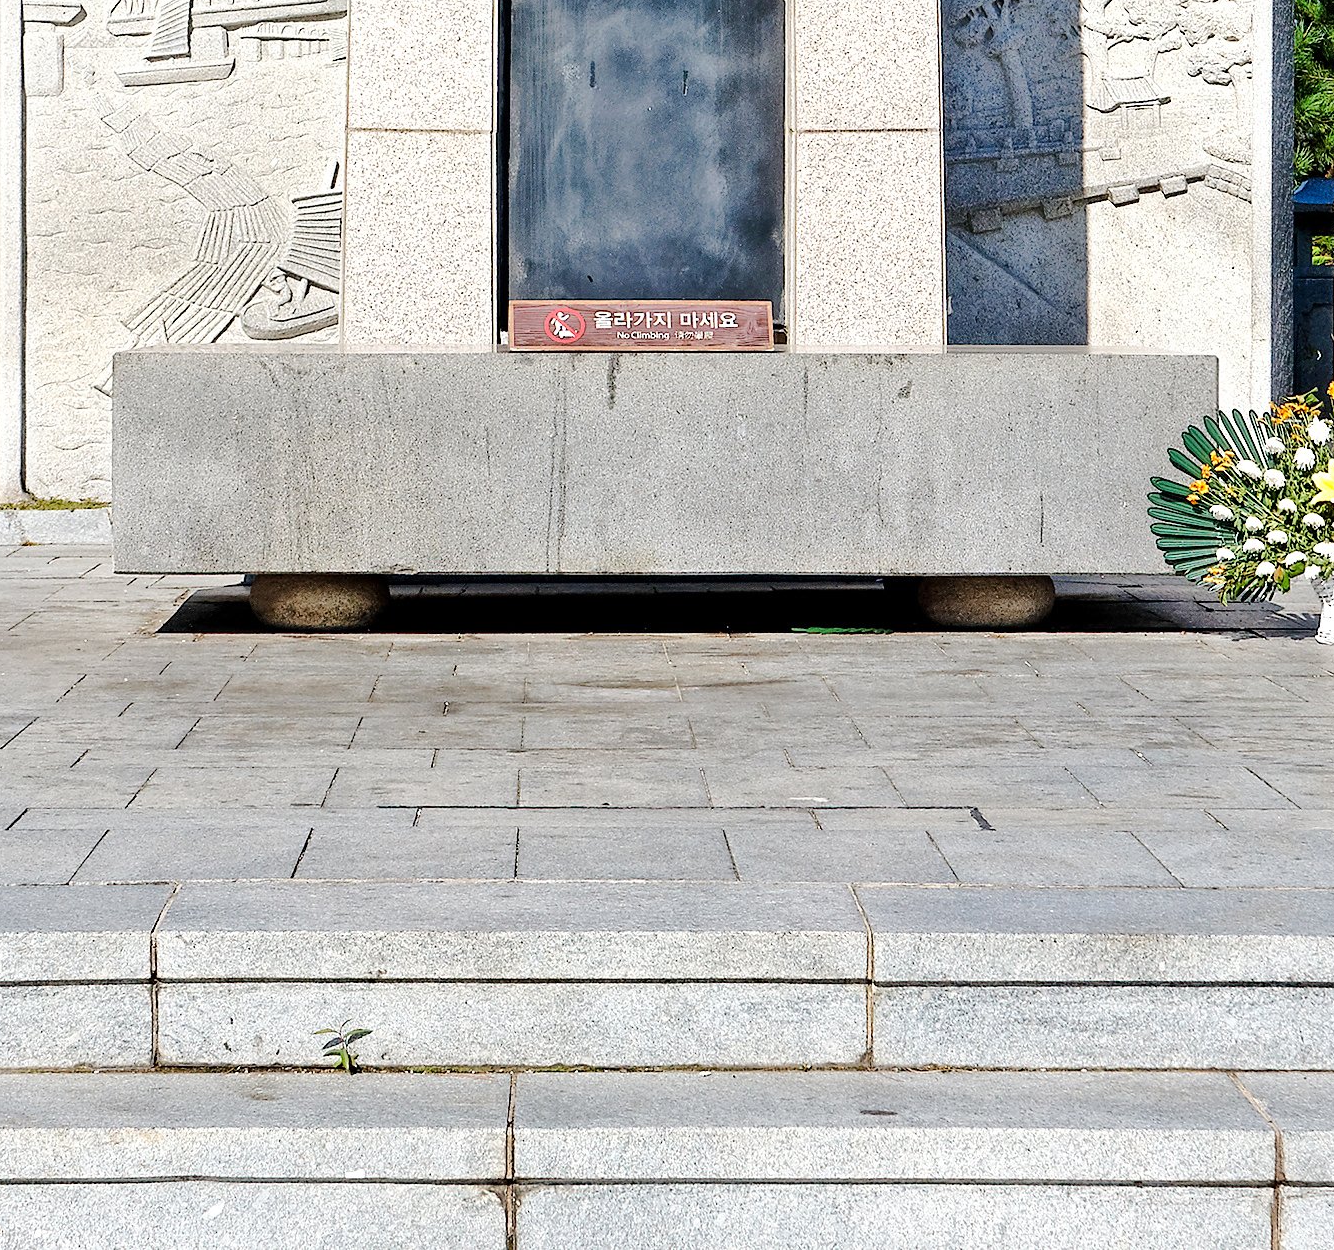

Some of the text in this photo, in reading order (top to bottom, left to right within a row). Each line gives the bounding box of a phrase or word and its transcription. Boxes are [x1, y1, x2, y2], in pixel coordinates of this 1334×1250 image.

[593, 311, 739, 329] 올라가지 마세요
[617, 331, 670, 341] No Climbing
